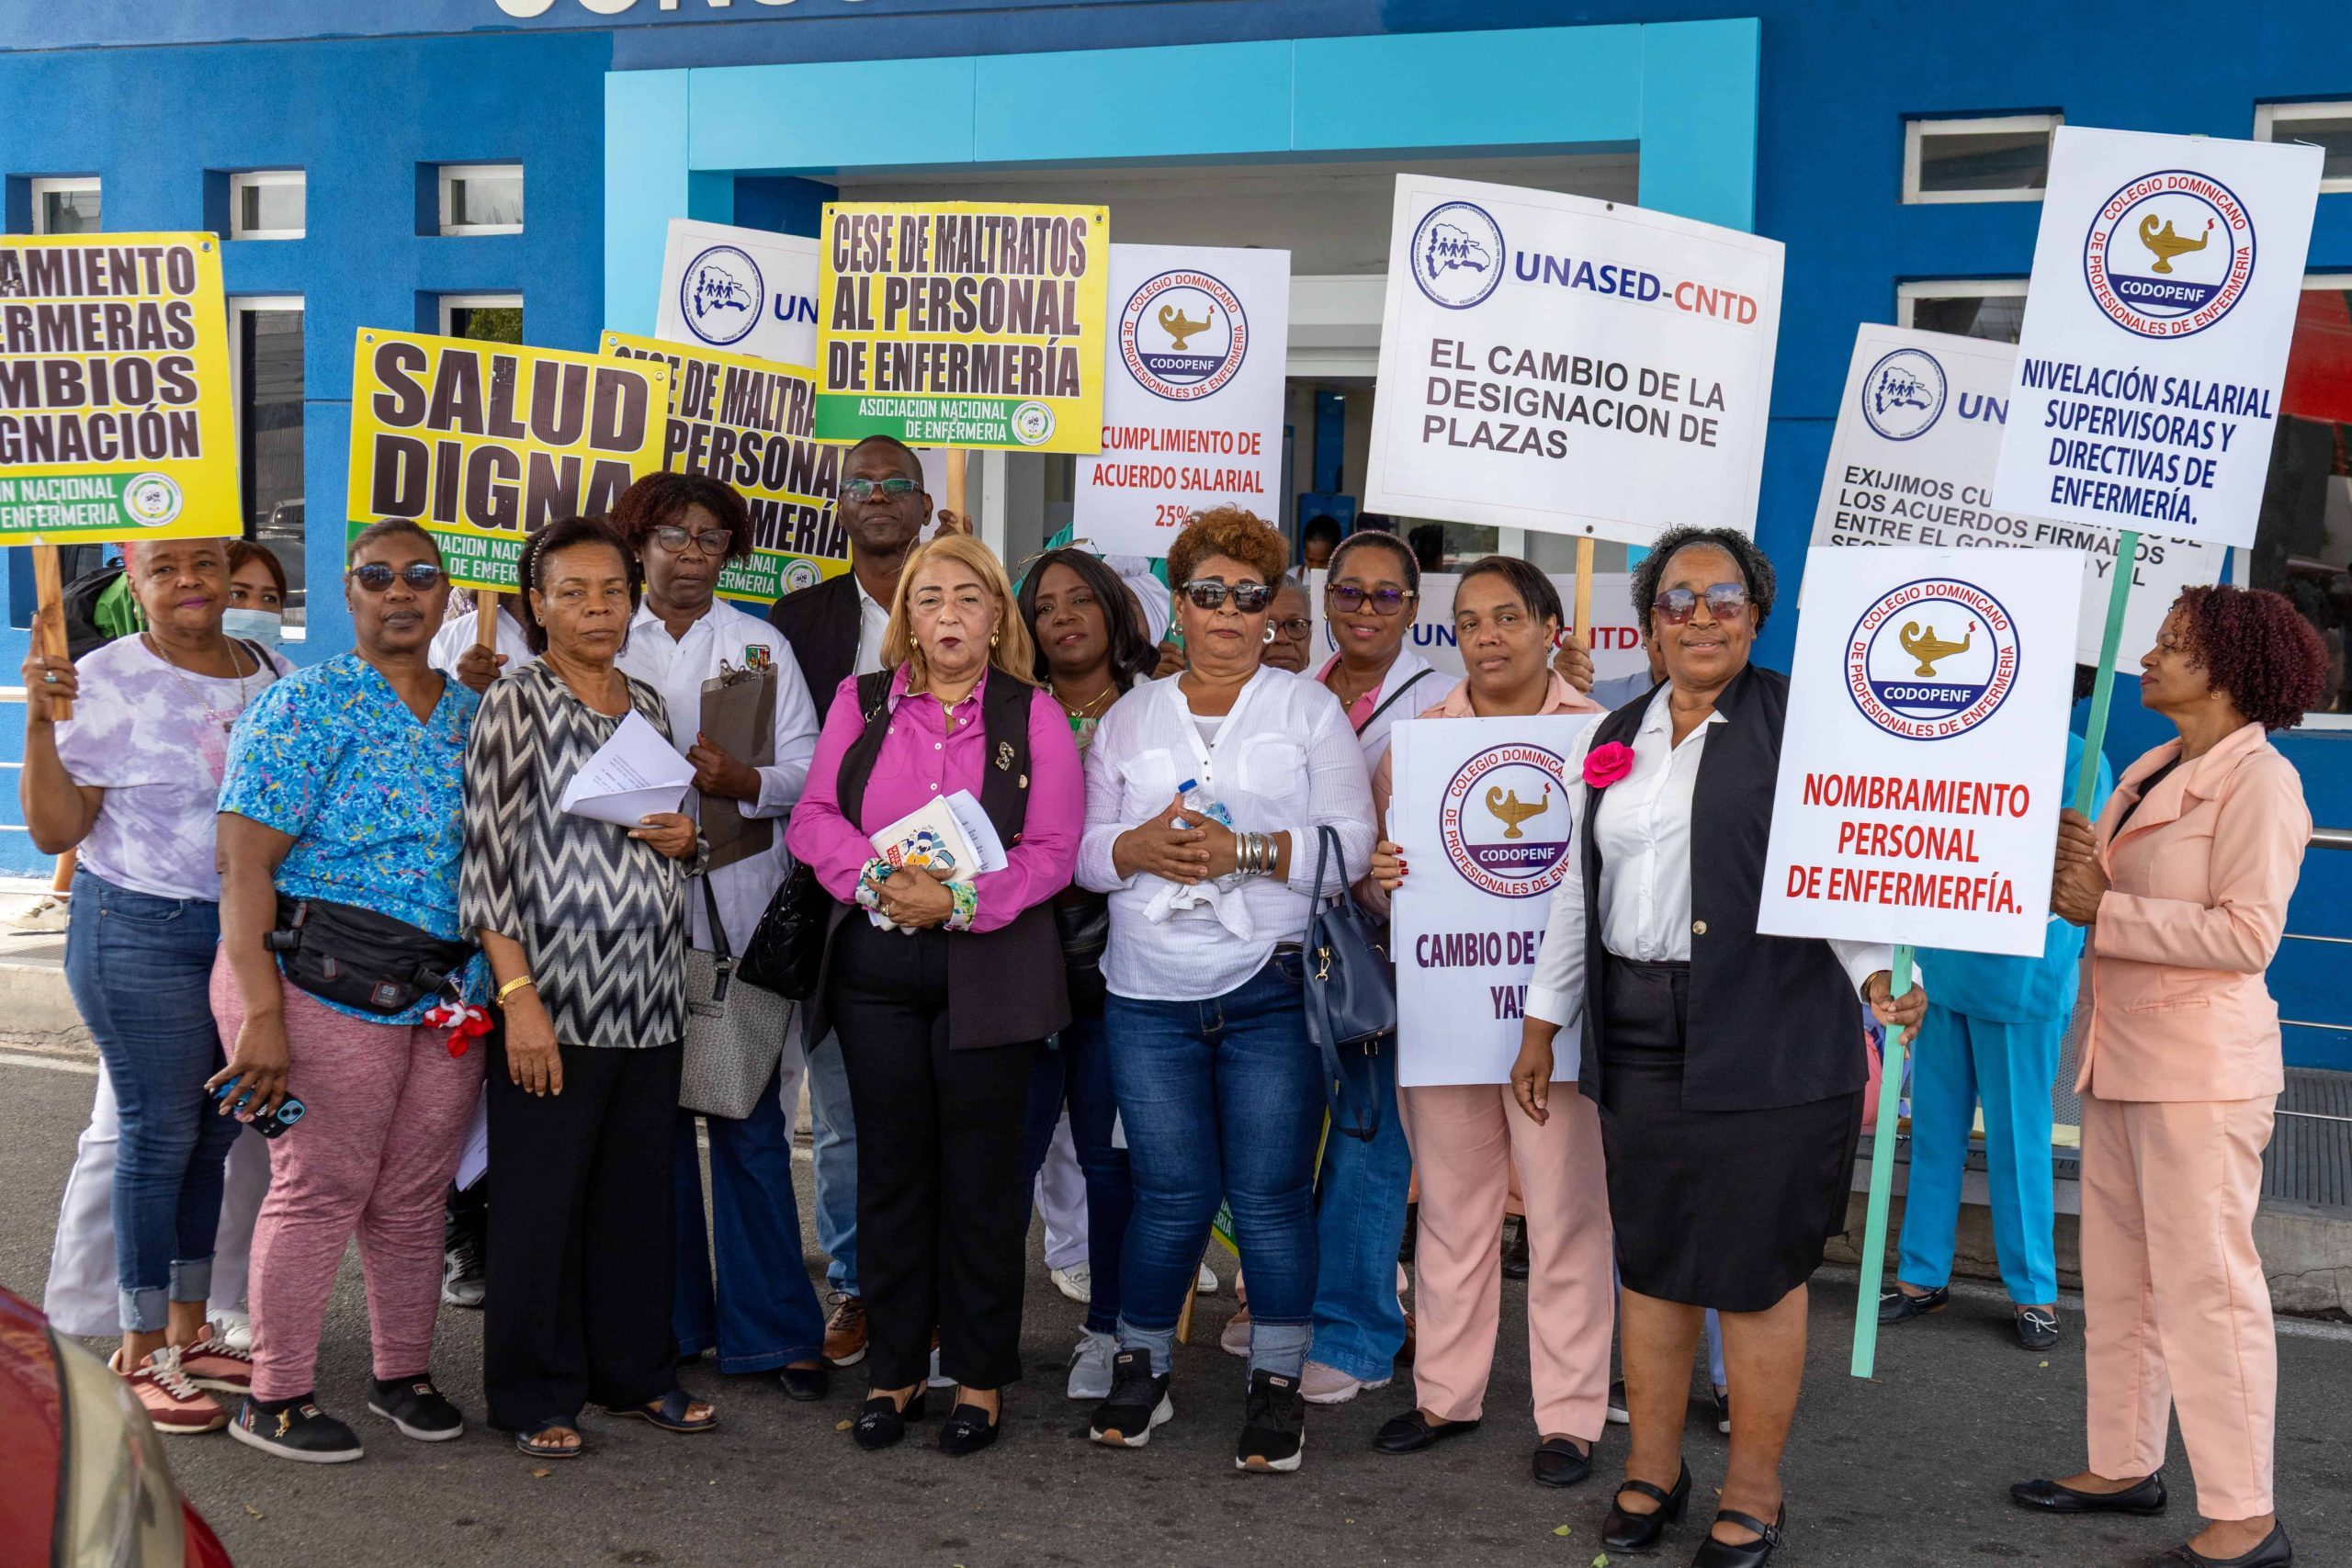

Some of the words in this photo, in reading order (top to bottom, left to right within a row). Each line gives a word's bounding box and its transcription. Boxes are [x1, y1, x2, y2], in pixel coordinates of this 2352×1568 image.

[2102, 176, 2162, 220] COLEGIO
[2167, 175, 2246, 230] DOMINICANO
[832, 214, 894, 273] CESE
[899, 215, 930, 273] DE
[934, 215, 1087, 276] MALTRATOS
[2089, 231, 2105, 251] DE
[831, 276, 875, 331] AL
[884, 276, 1080, 335] PERSONAL
[1129, 276, 1170, 312] COLEGIO
[1174, 274, 1238, 313] DOMINICANO
[1515, 251, 1758, 325] UNASED-CNTD
[2089, 255, 2166, 333] PROFESIONALES
[2120, 280, 2206, 302] CODOPENF
[2193, 246, 2250, 326] ENFERMERIA
[0, 301, 195, 353] RMERAS
[774, 293, 818, 324] UN
[1123, 321, 1133, 335] DE
[2171, 319, 2192, 333] DE
[828, 341, 866, 390] DE
[875, 337, 1080, 397] ENFERMERÍA
[1123, 340, 1189, 396] PROFESIONALES
[1149, 356, 1215, 371] CODOPENF
[1207, 324, 1243, 389] ENFERMERIA
[1430, 338, 1476, 371] EL
[1487, 345, 1629, 391] CAMBIO
[1639, 367, 1680, 401] DE
[1690, 378, 1725, 412] LA
[0, 356, 198, 408] MBIOS
[373, 342, 649, 453] SALUD
[681, 358, 720, 421] DE
[1192, 383, 1207, 395] DE
[2021, 358, 2158, 404] NIVELACIÓN
[2162, 377, 2272, 420] SALARIAL
[859, 398, 936, 418] ASOCIACION
[941, 400, 1007, 420] NACIONAL
[1426, 377, 1669, 438] DESIGNACION
[1679, 414, 1718, 447] DE
[1958, 392, 2009, 424] UN
[2044, 399, 2214, 450] SUPERVISORAS
[2222, 423, 2236, 453] Y
[906, 420, 922, 438] DE
[925, 421, 1006, 441] ENFERMERIA
[1102, 425, 1233, 455] CUMPLIMIENTO
[1238, 432, 1261, 456] DE
[1423, 415, 1567, 459] PLAZAS
[662, 419, 852, 499] PERSONA
[1092, 463, 1176, 489] ACUERDO
[1181, 468, 1263, 494] SALARIAL
[2049, 437, 2180, 484] DIRECTIVAS
[2184, 458, 2217, 489] DE
[21, 478, 118, 502] NACIONAL
[371, 434, 632, 533] DIGNA
[1844, 466, 1954, 501] EXIJIMOS
[1962, 486, 1993, 508] CU
[2051, 475, 2198, 525] ENFERMERÍA.
[1, 503, 120, 528] ENFERMERIA
[1155, 504, 1192, 527] 25%
[1838, 489, 1886, 513] LOS
[1891, 498, 2028, 538] ACUERDOS
[2035, 524, 2165, 564] FIRMAOS
[449, 557, 469, 577] DE
[492, 541, 524, 561] NAC
[1834, 512, 1913, 541] ENTRE
[1919, 526, 1948, 547] EL
[2096, 559, 2111, 579] Y
[1860, 585, 1920, 631] COLEGIO
[1924, 583, 2008, 631] DOMINICANO
[1413, 624, 1457, 647] UN
[1850, 640, 1865, 660] DE
[1849, 664, 1933, 736] PROFESIONALES
[1883, 685, 1972, 703] CODOPENF
[1961, 646, 2014, 727] ENFERMERIA
[1939, 719, 1960, 734] DE
[1450, 751, 1498, 797] COLEGIO
[1501, 749, 1564, 779] DOMINICA
[1444, 808, 1455, 827] DE
[1804, 773, 2030, 818] NOMBRAMIENTO
[1445, 830, 1528, 893] PROFESIONALES
[1479, 848, 1555, 863] CODOPENF
[1838, 821, 1979, 863] PERSONAL
[1531, 875, 1550, 890] DE
[1550, 853, 1569, 881] ENF
[1786, 864, 1823, 899] DE
[1827, 867, 2022, 915] ENFERMERFÍA.
[1416, 931, 1502, 969] CAMBIO
[1507, 931, 1535, 965] DE
[1489, 985, 1529, 1020] YA!
